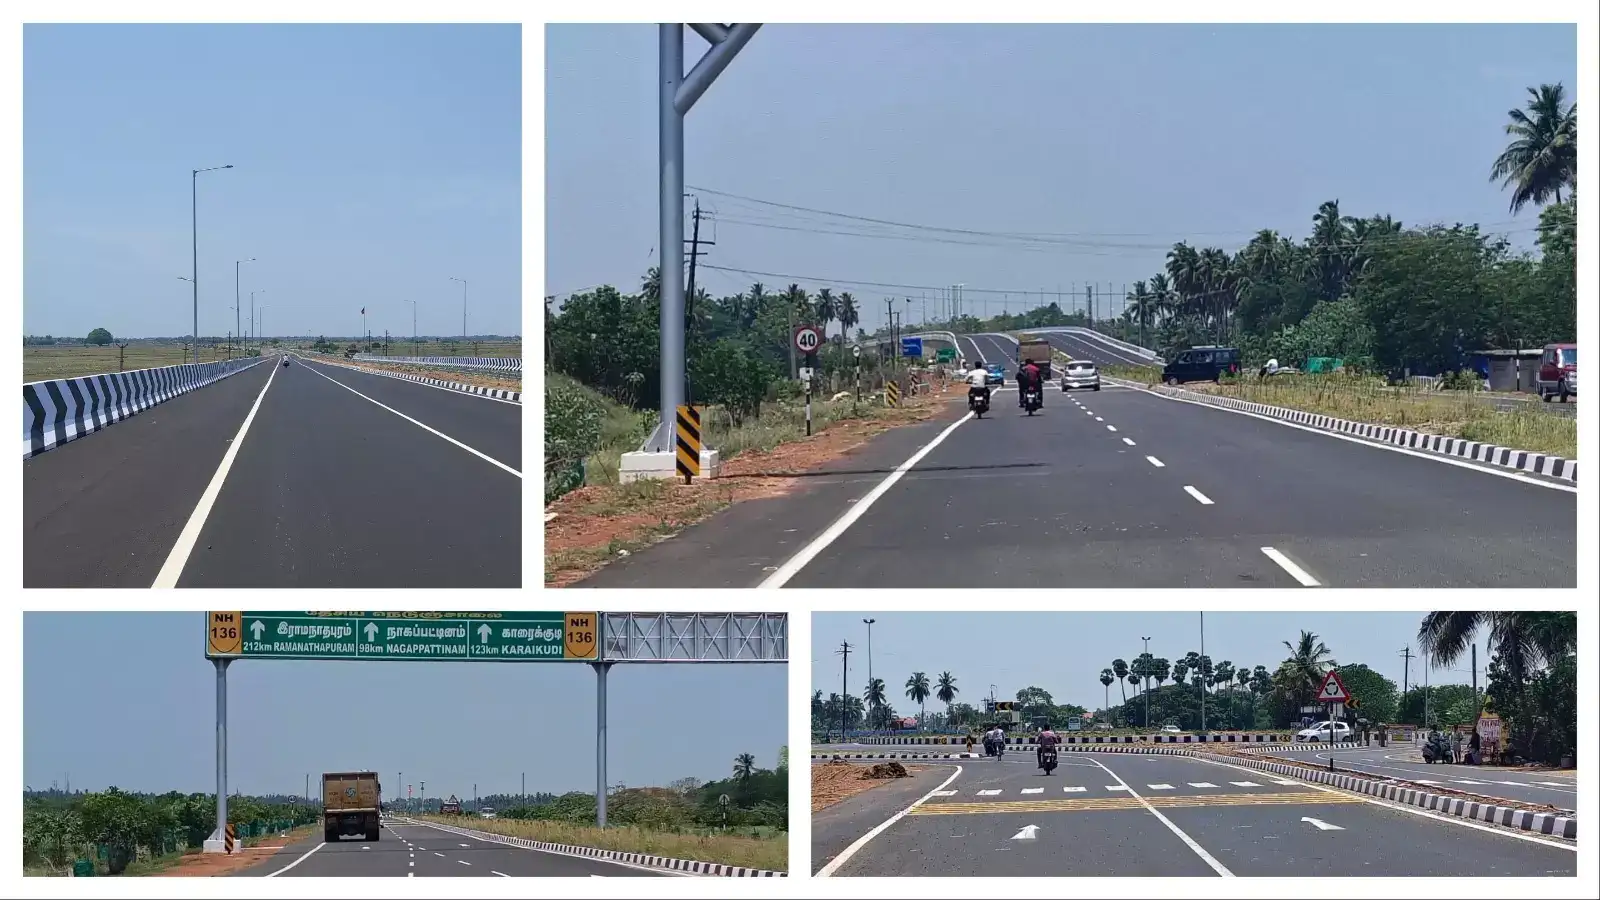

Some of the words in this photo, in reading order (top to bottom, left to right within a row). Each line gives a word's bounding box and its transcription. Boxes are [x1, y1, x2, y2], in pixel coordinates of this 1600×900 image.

[800, 333, 816, 347] 40
[214, 614, 234, 623] NH
[570, 618, 589, 627] NH
[210, 627, 237, 639] 136
[277, 621, 352, 639] இராமநாதபுரம்
[386, 623, 466, 640] நாகப்பட்டினம்
[501, 625, 563, 641] காரைக்குடி
[567, 631, 593, 643] 136
[243, 641, 272, 651] 212km
[273, 642, 355, 652] RAMANATHAPURAM
[359, 643, 384, 653] 98km
[386, 644, 466, 654] NAGAPPATTINAM
[470, 645, 499, 654] 123km
[501, 645, 563, 655] KARAIKUDI
